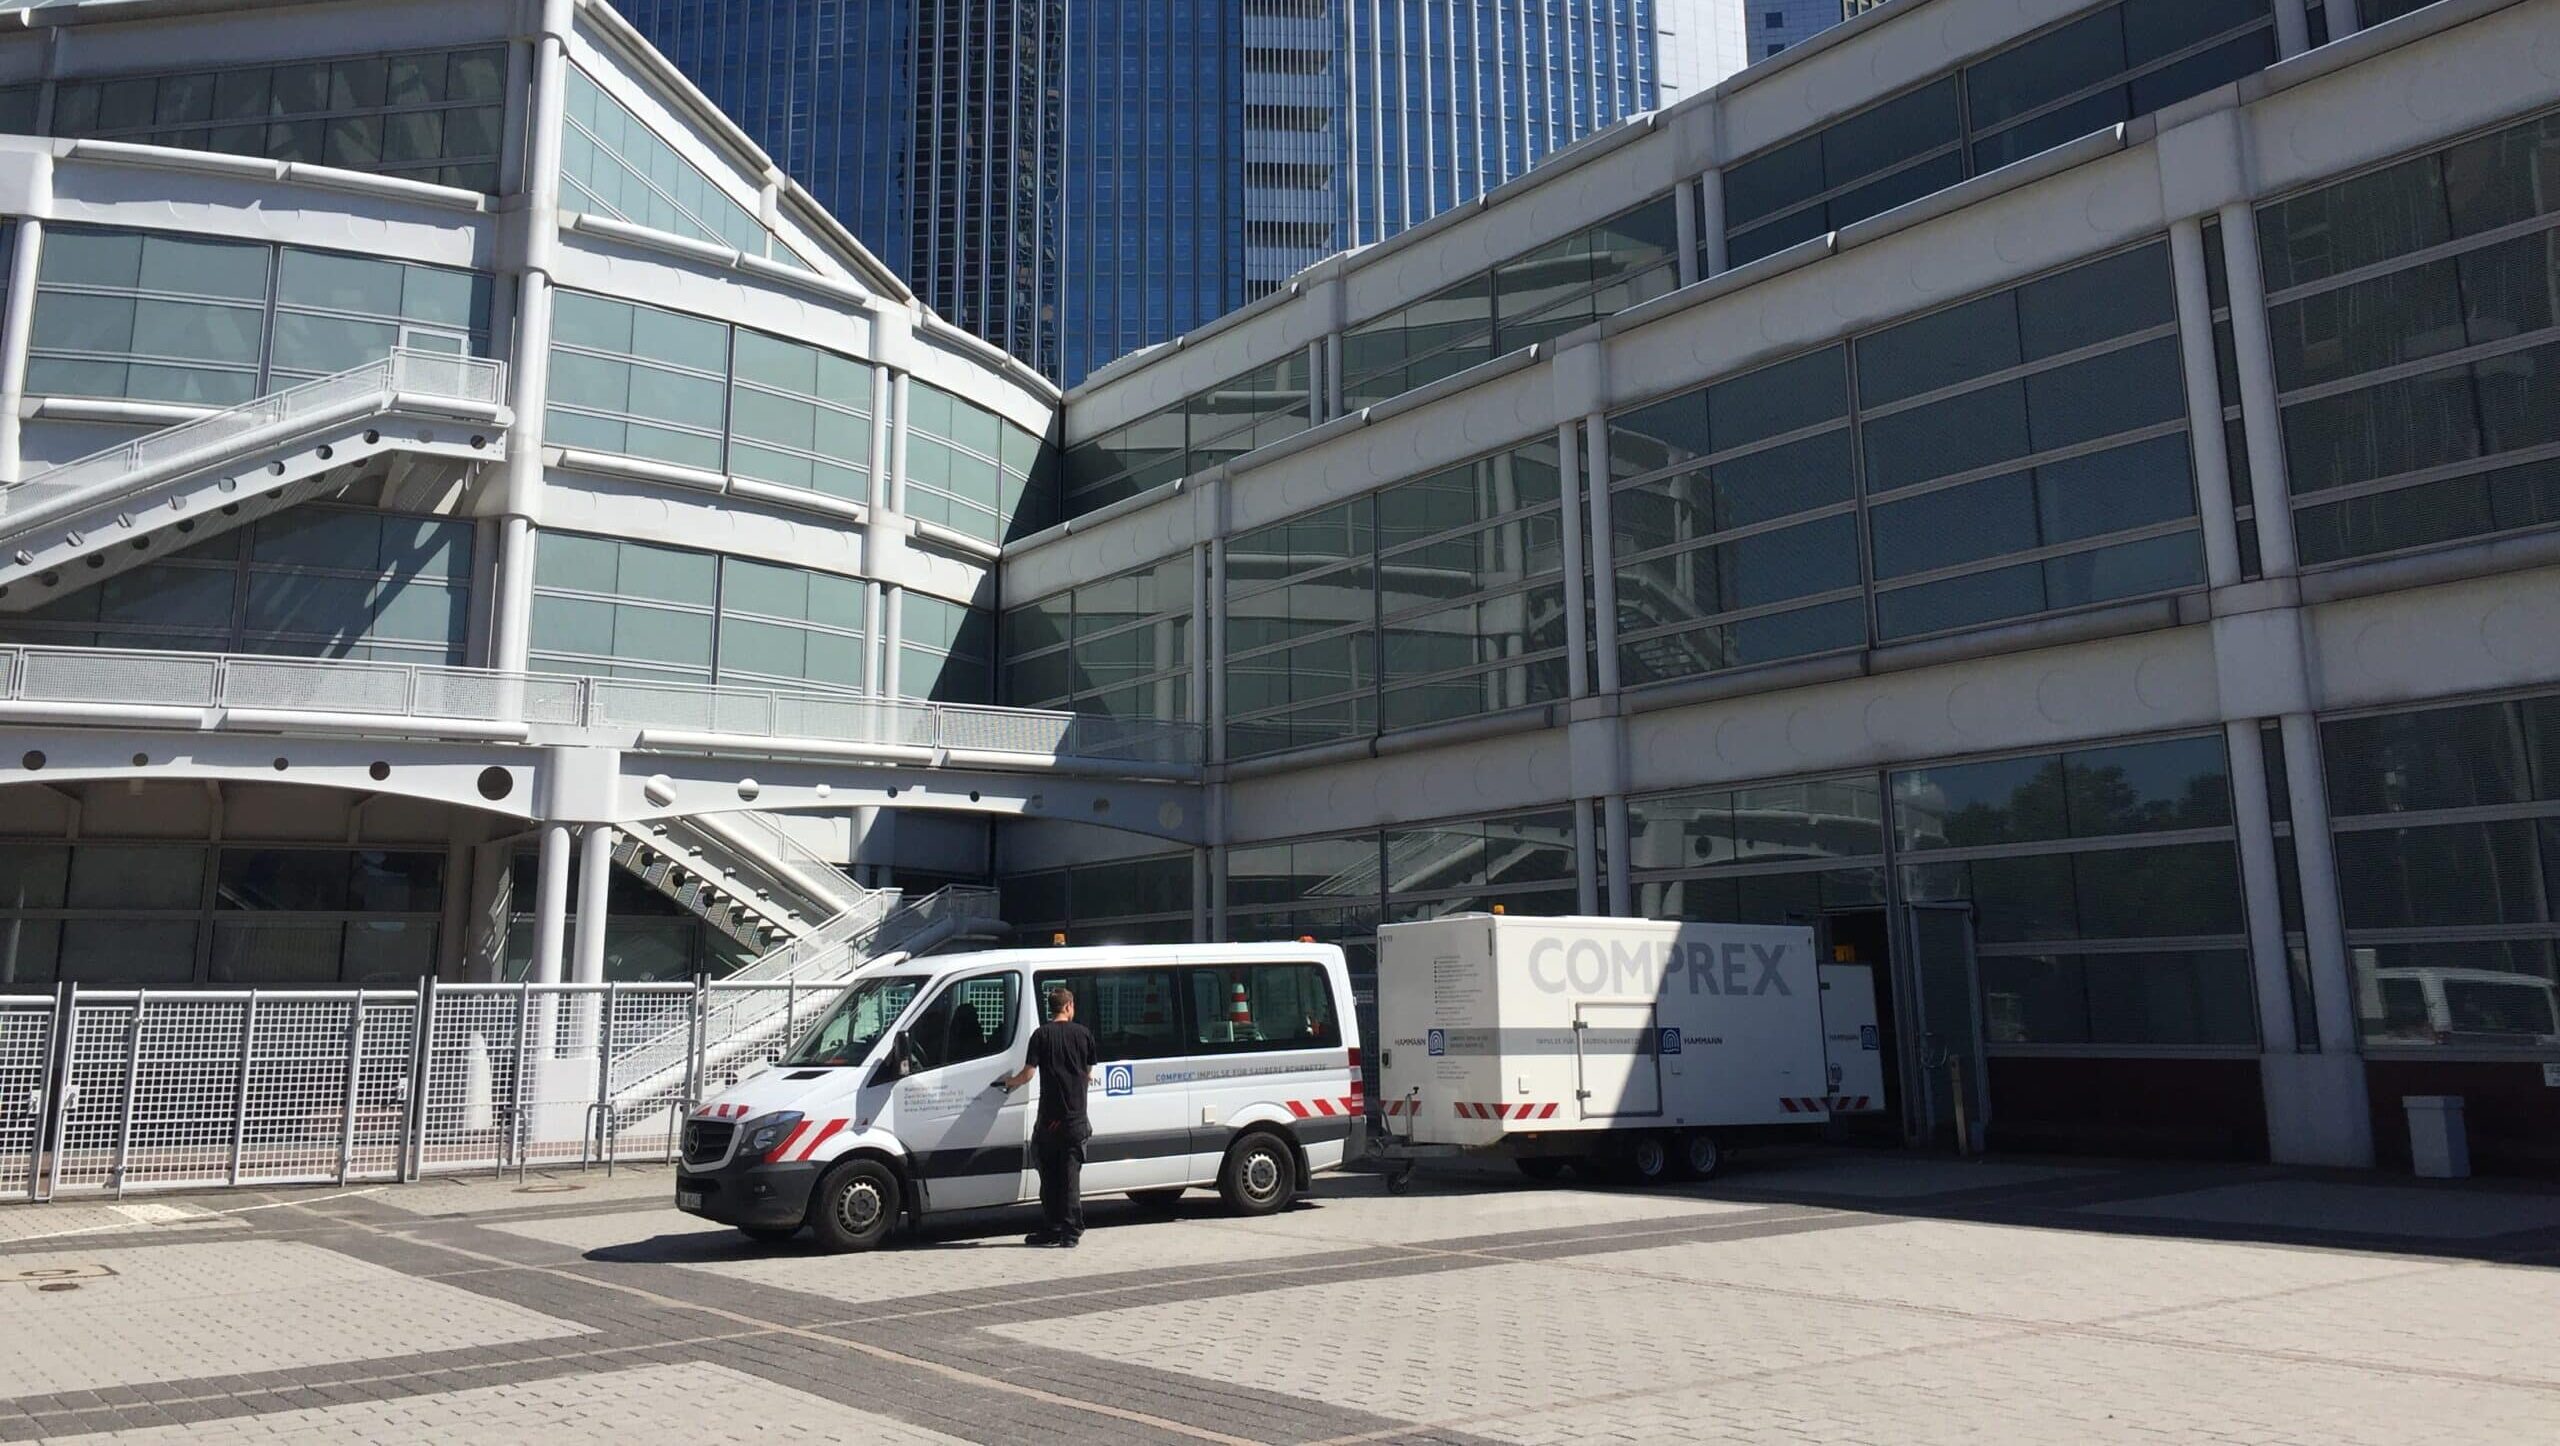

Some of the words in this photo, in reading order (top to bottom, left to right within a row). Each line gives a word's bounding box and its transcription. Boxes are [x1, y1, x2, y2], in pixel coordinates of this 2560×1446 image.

[1528, 936, 1793, 997] COMPREX
[1394, 1037, 1426, 1046] HAMMANN
[1684, 1036, 1723, 1046] HAMMANN
